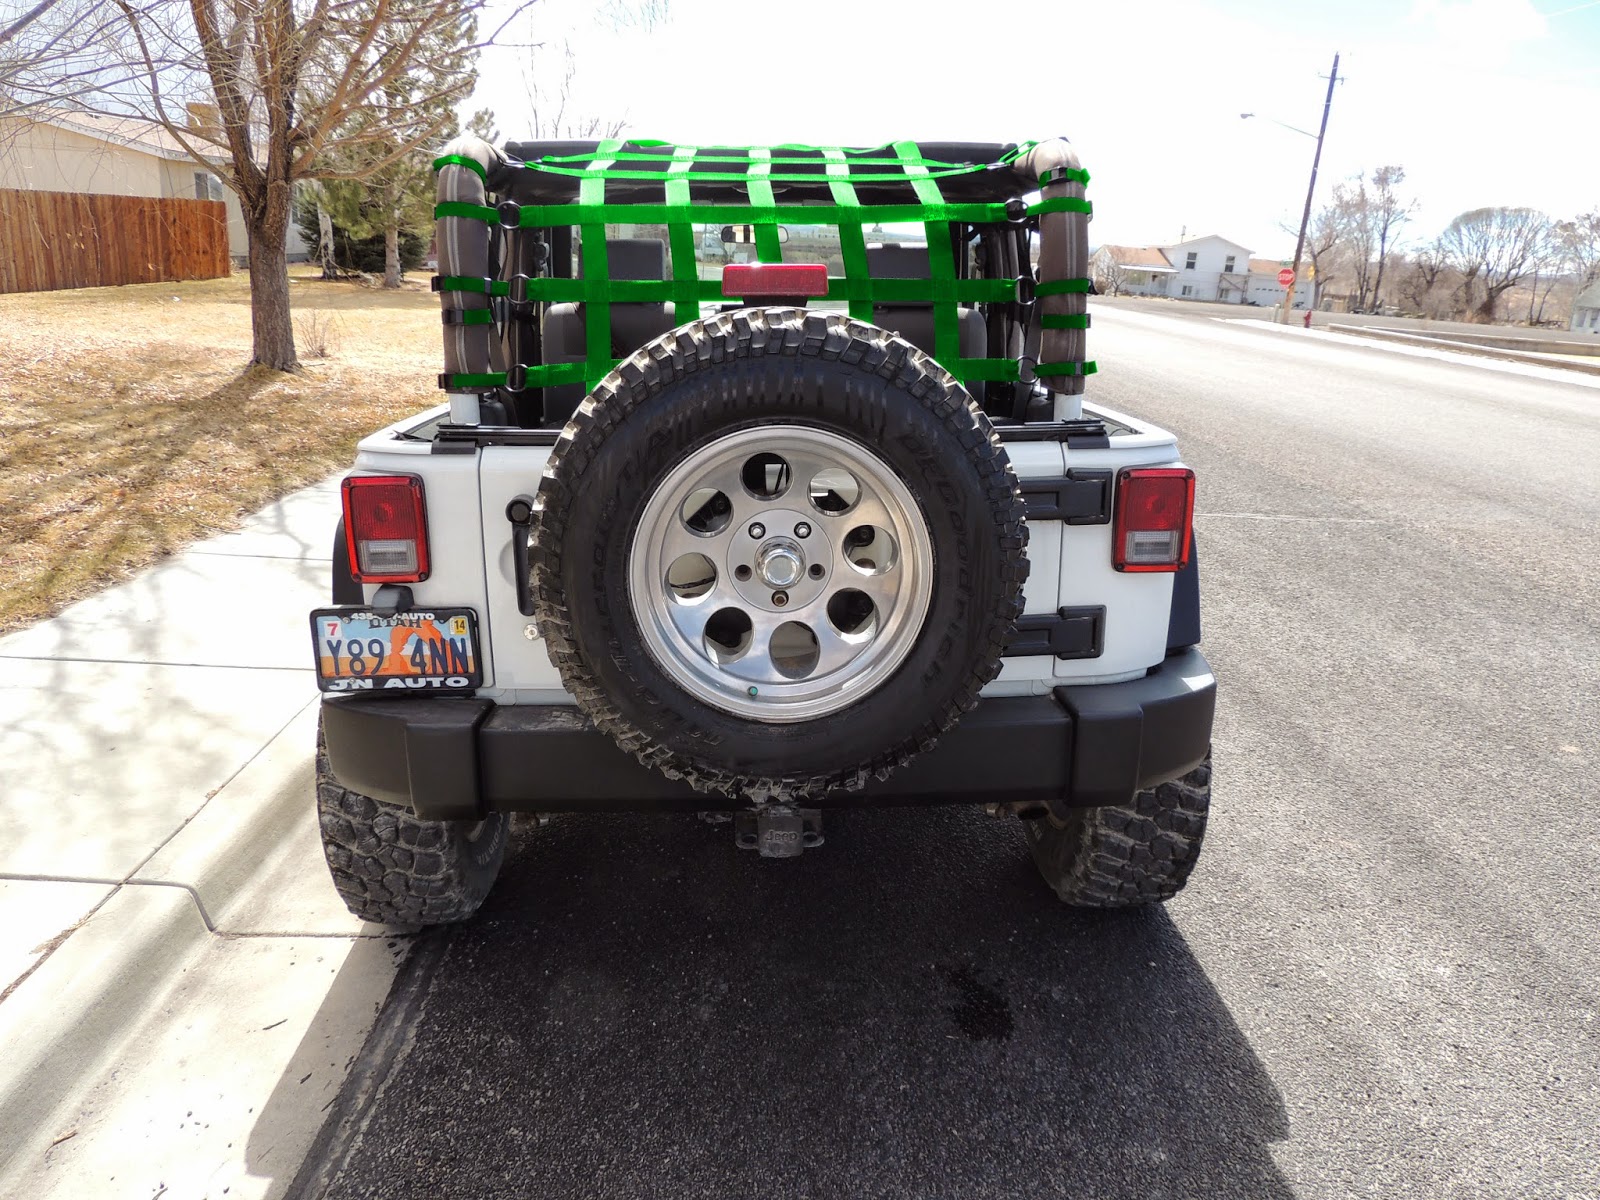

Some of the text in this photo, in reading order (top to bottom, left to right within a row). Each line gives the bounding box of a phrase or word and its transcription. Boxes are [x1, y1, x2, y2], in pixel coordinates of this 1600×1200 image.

[1278, 273, 1294, 281] STOP
[327, 623, 338, 636] 7
[369, 618, 422, 629] UTAH
[454, 619, 465, 630] 14
[326, 637, 469, 676] Y89 4NN
[384, 676, 469, 689] AUTO
[766, 829, 798, 842] Jeep
